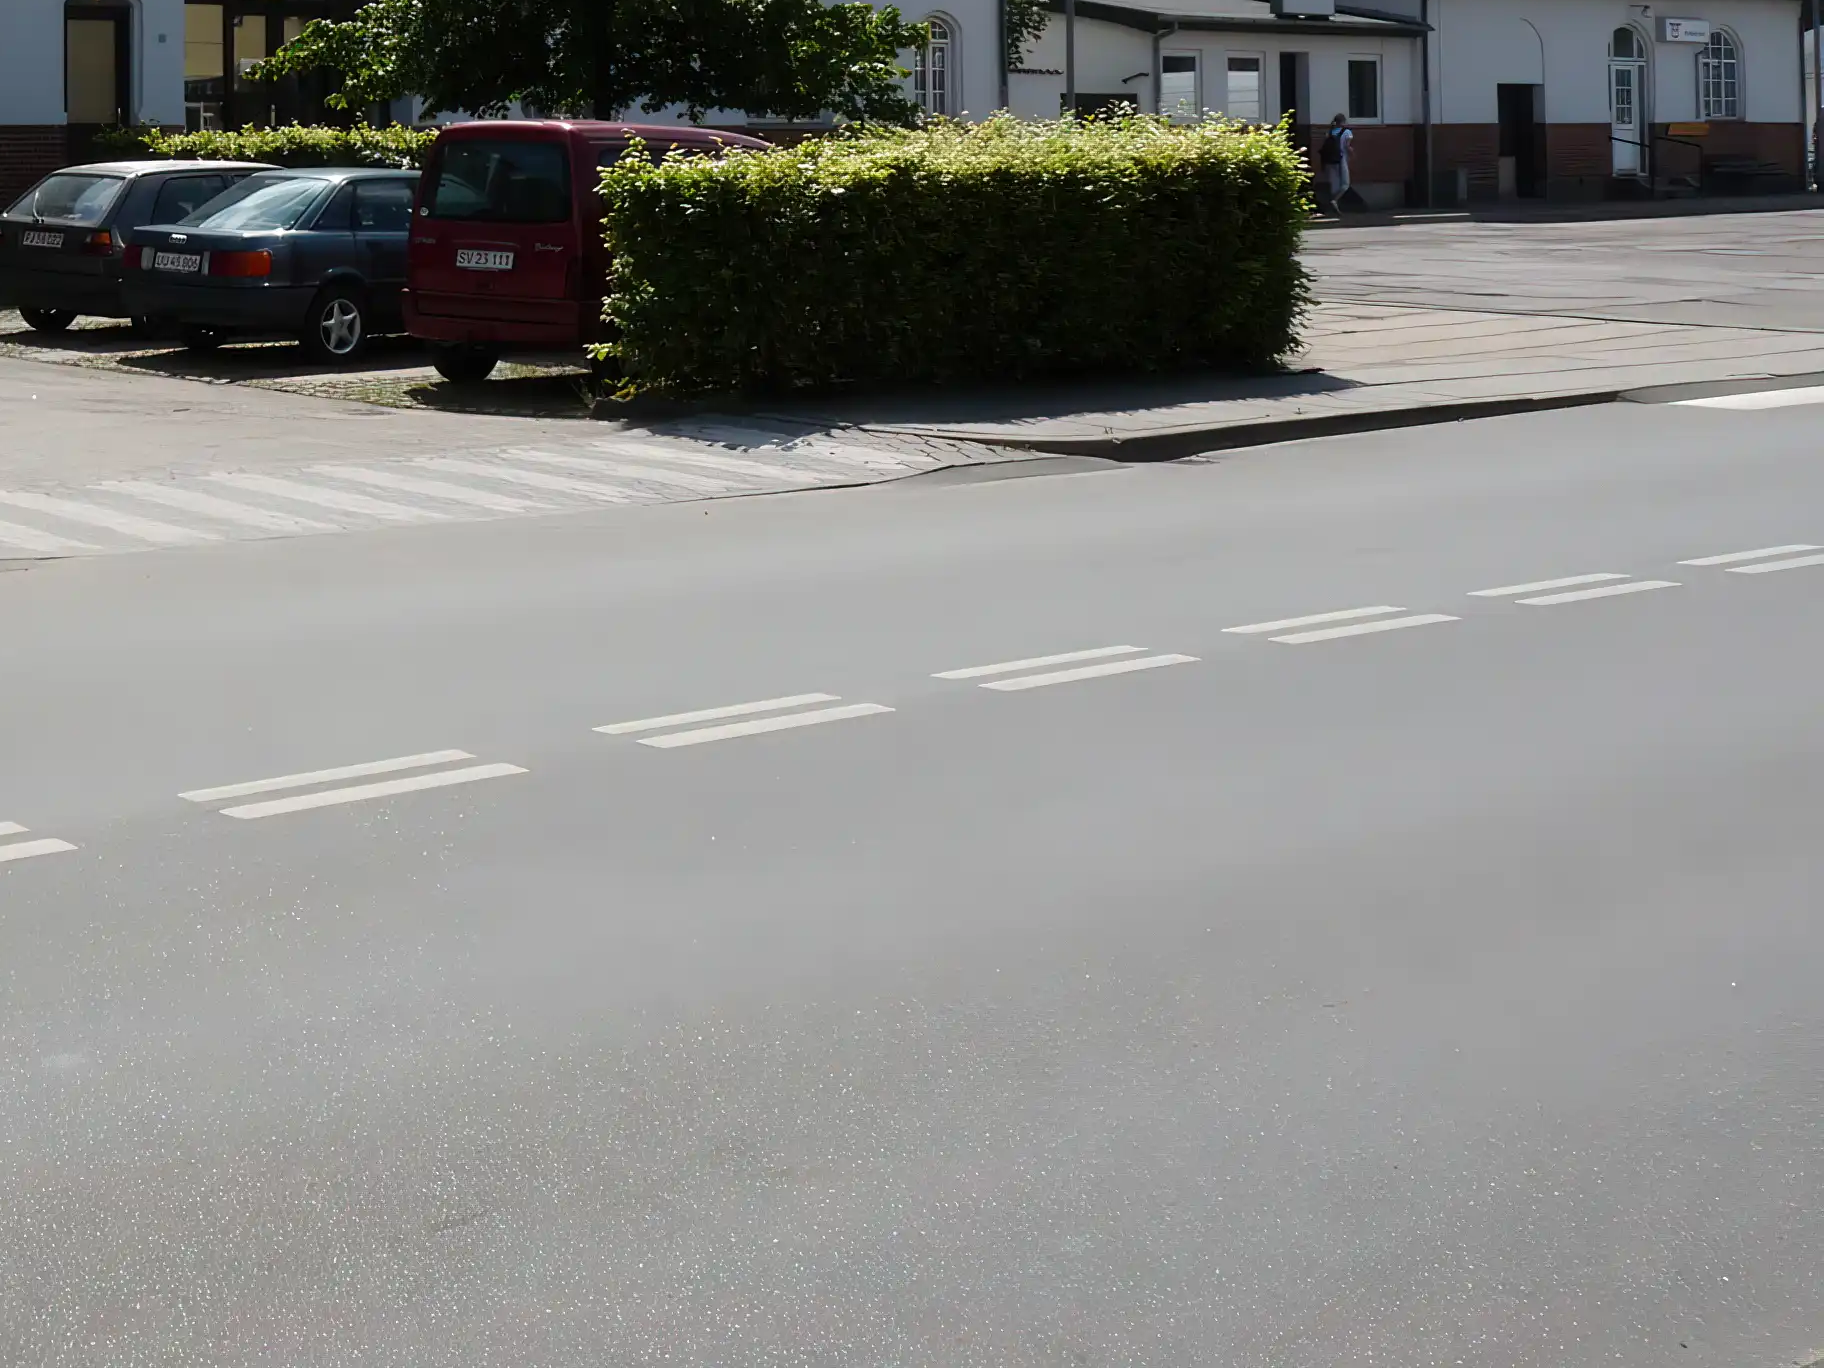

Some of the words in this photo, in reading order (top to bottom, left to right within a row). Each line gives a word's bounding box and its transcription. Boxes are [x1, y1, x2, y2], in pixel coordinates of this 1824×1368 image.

[458, 252, 474, 264] SV
[475, 252, 488, 264] 23
[492, 253, 510, 266] 111
